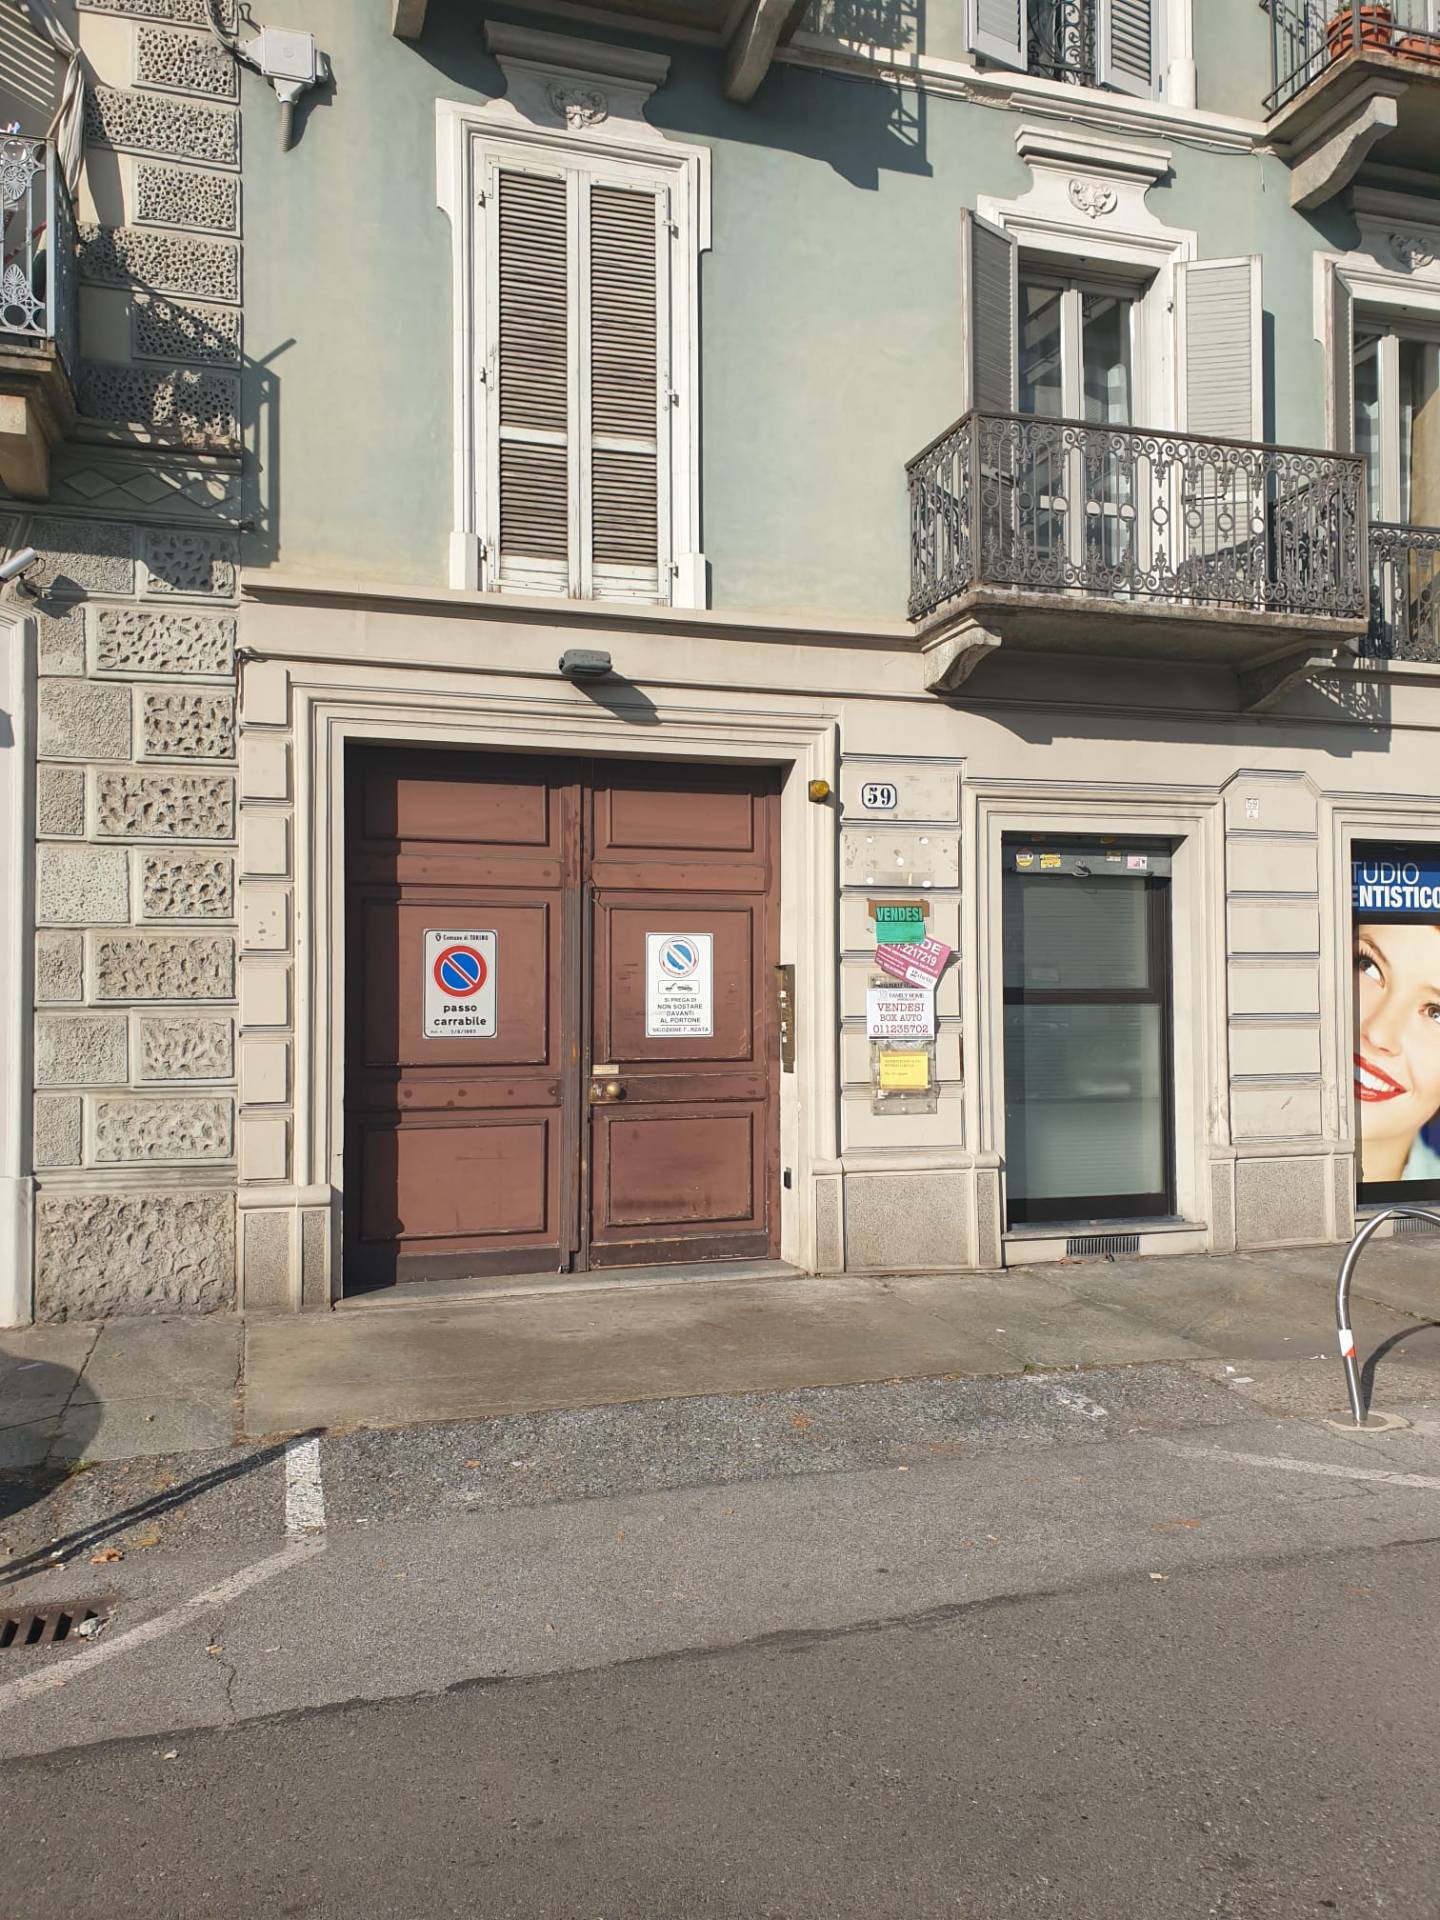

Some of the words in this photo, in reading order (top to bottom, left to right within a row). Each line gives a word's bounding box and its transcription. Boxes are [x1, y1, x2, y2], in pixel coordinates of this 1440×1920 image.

[868, 787, 891, 805] 59
[877, 907, 923, 921] VENDESI
[443, 1004, 478, 1014] passo
[877, 1002, 925, 1012] VENDESI
[434, 1016, 487, 1026] carrabile
[880, 1013, 898, 1022] BOX
[900, 1013, 923, 1022] AUTO
[872, 1024, 929, 1034] 011235702
